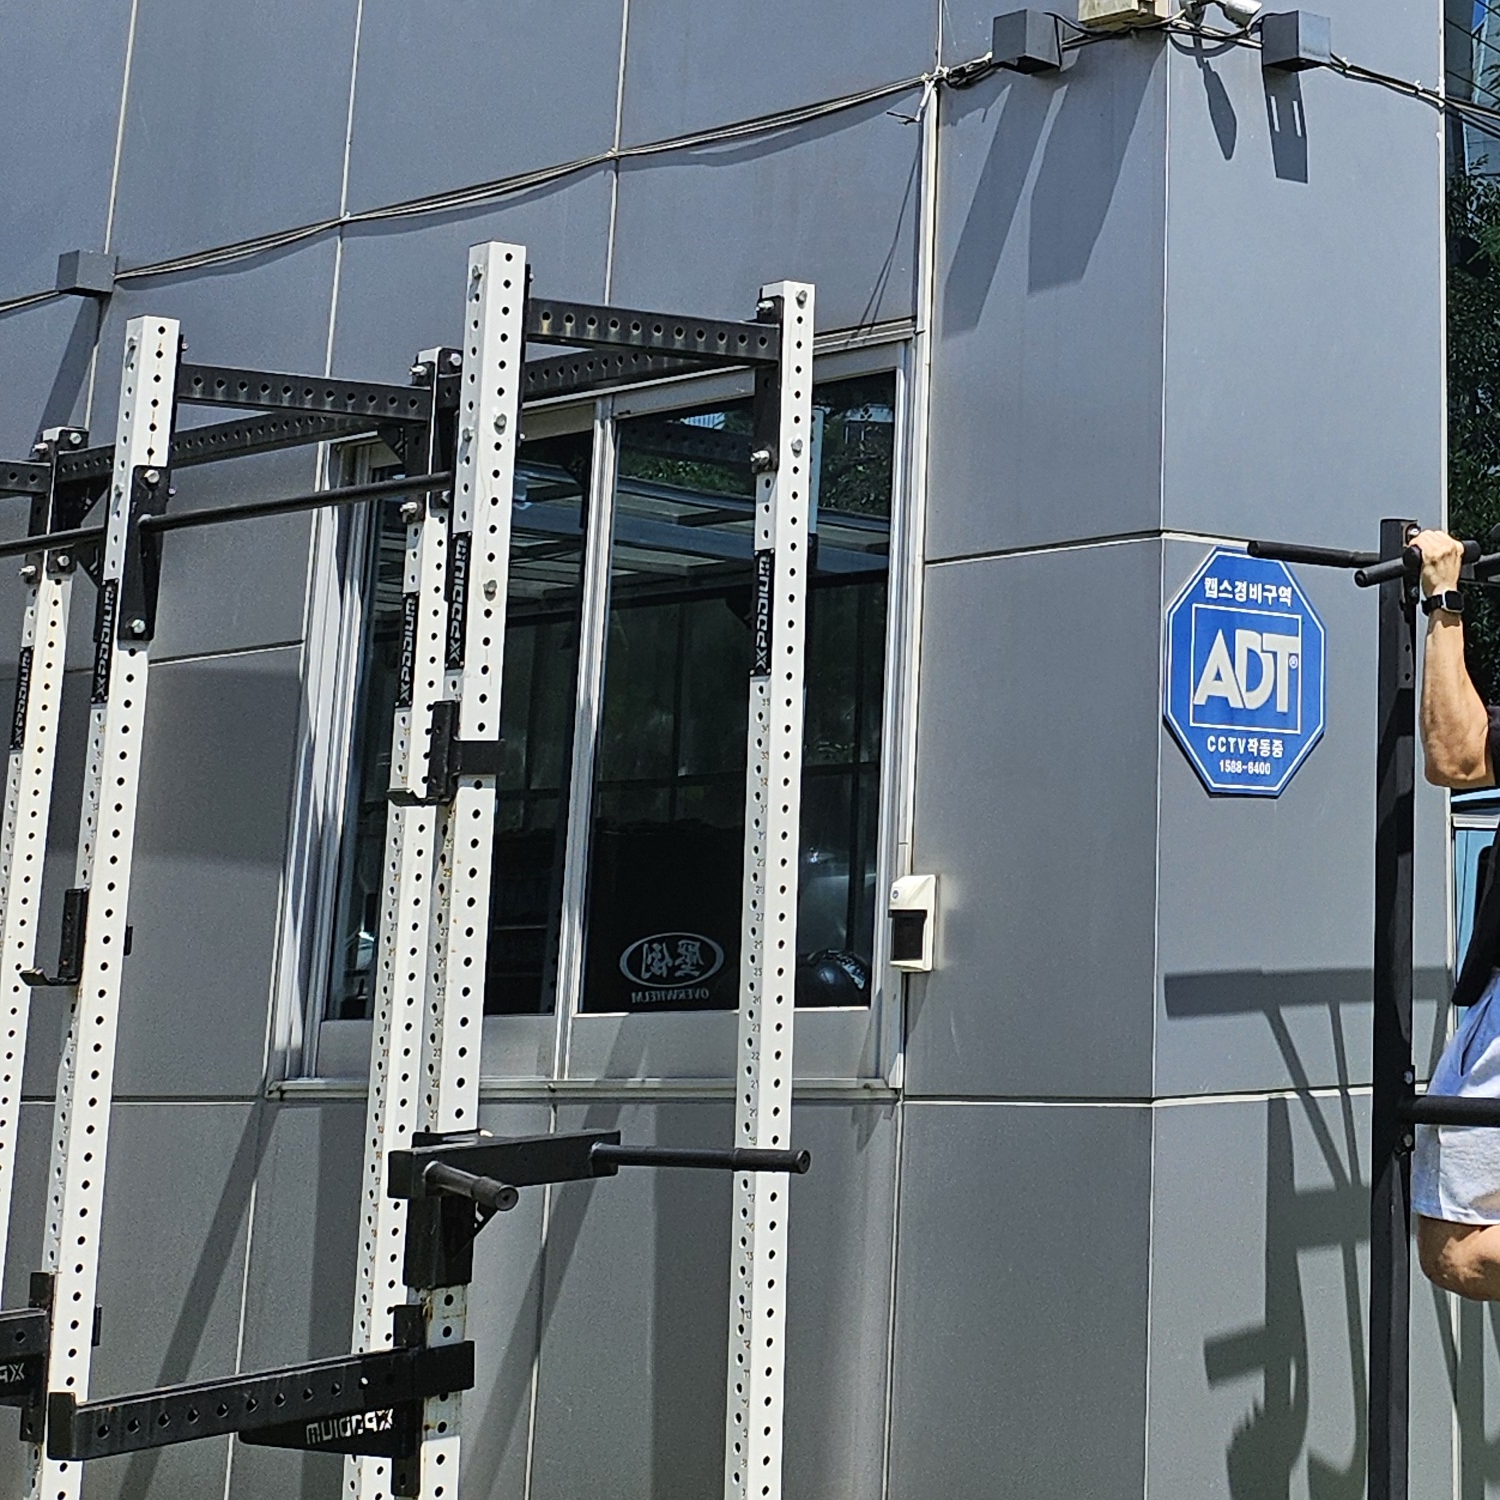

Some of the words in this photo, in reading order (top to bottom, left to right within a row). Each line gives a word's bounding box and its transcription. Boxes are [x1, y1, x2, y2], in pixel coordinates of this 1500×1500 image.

[450, 539, 467, 662] XPODIUM
[755, 556, 770, 669] XPODIUM
[1192, 629, 1299, 713] ADT
[1219, 759, 1271, 775] 1588-6400
